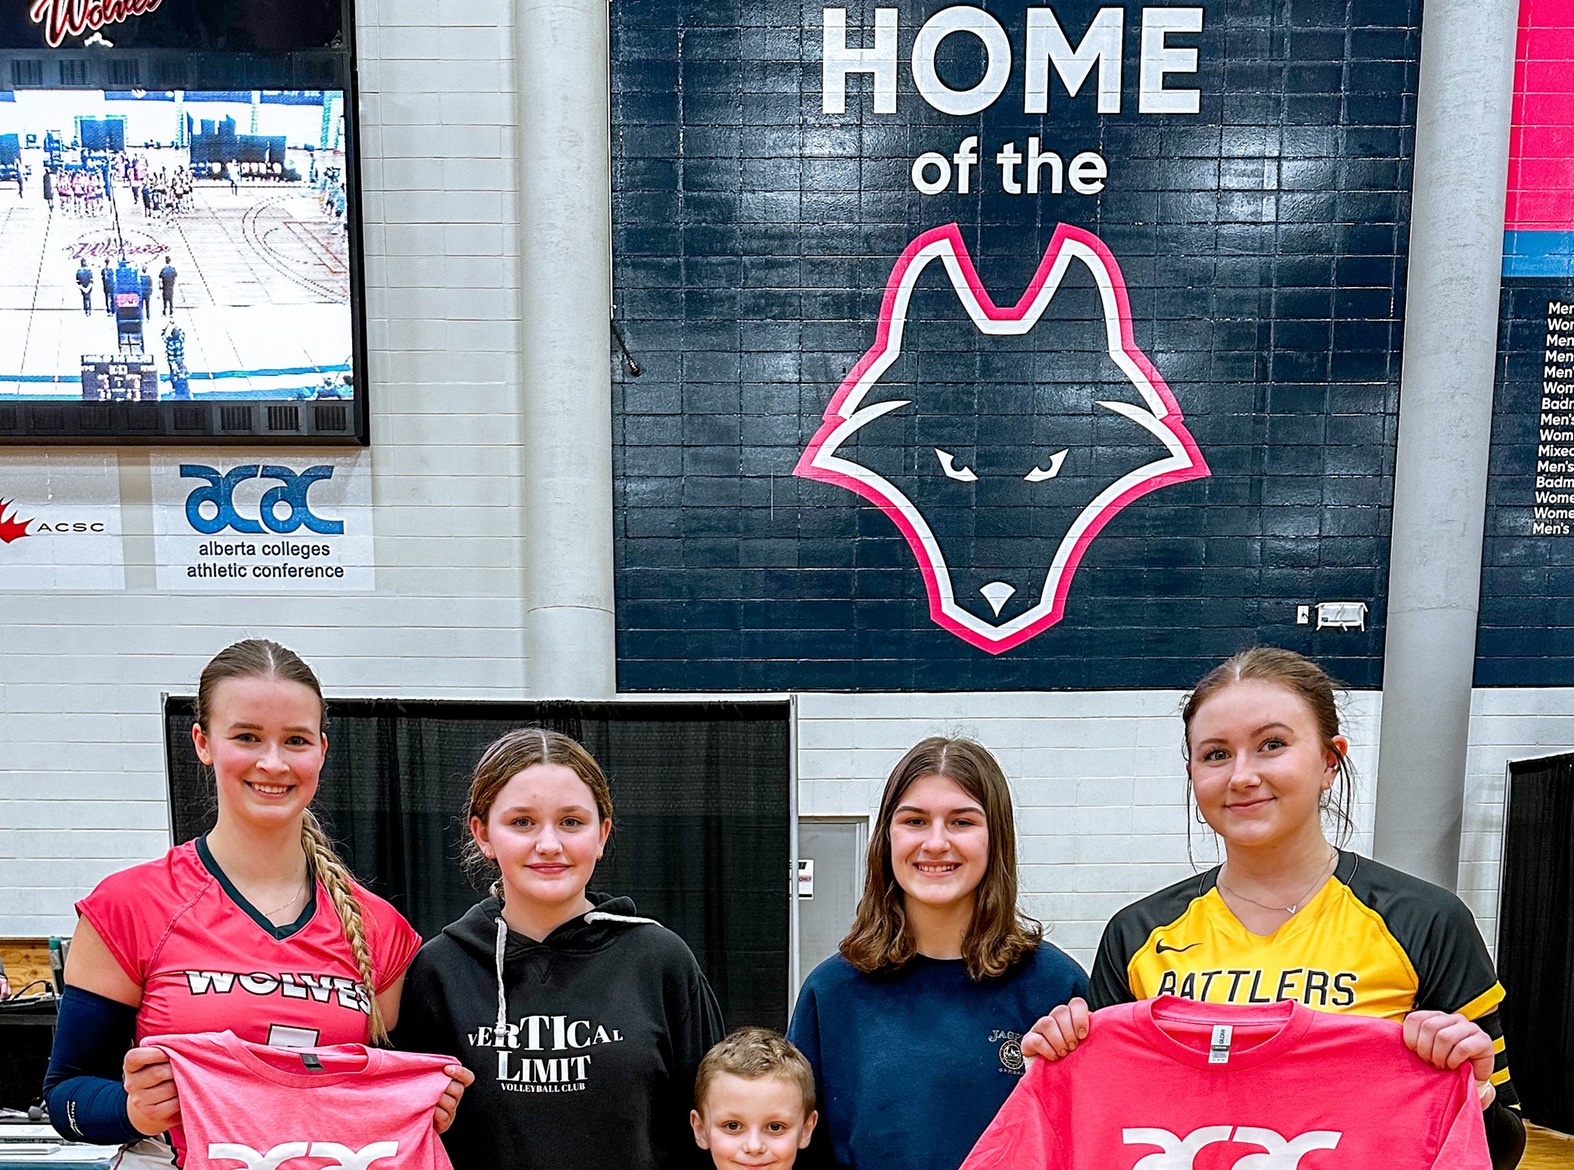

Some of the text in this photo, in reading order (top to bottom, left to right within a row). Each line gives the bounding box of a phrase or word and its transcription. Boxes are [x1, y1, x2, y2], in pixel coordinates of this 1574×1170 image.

[822, 5, 1205, 116] HOME
[911, 135, 1108, 195] of the
[36, 522, 105, 533] ACSC
[1532, 522, 1570, 535] Men's
[198, 540, 331, 560] alberta colleges
[186, 563, 345, 578] athletic conference
[184, 969, 371, 1016] WOLVES
[1156, 968, 1358, 1007] RATTLERS
[495, 1050, 591, 1084] LIMIT
[500, 1082, 586, 1093] VOLLEYBALL CLUB
